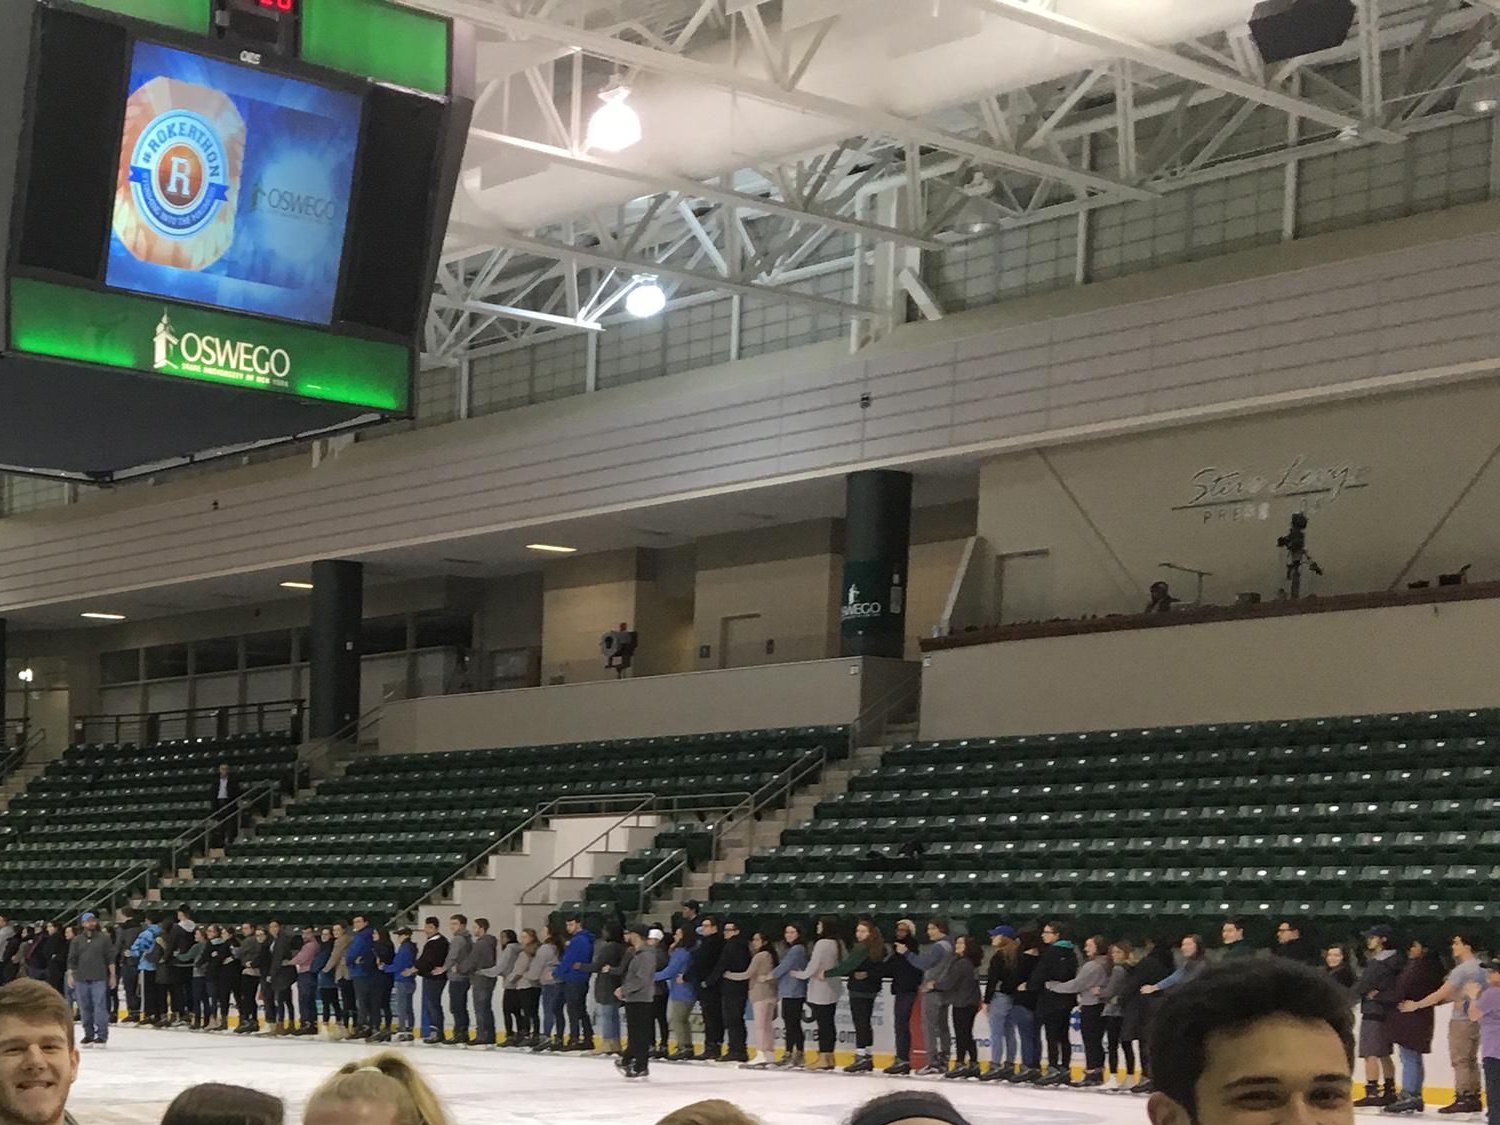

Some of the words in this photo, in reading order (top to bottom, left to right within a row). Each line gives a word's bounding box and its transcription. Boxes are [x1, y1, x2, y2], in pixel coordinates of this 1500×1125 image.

[143, 121, 220, 177] #ROKERTHON
[167, 156, 191, 196] R
[267, 187, 335, 220] OSWEGO
[180, 332, 291, 378] OSWEGO
